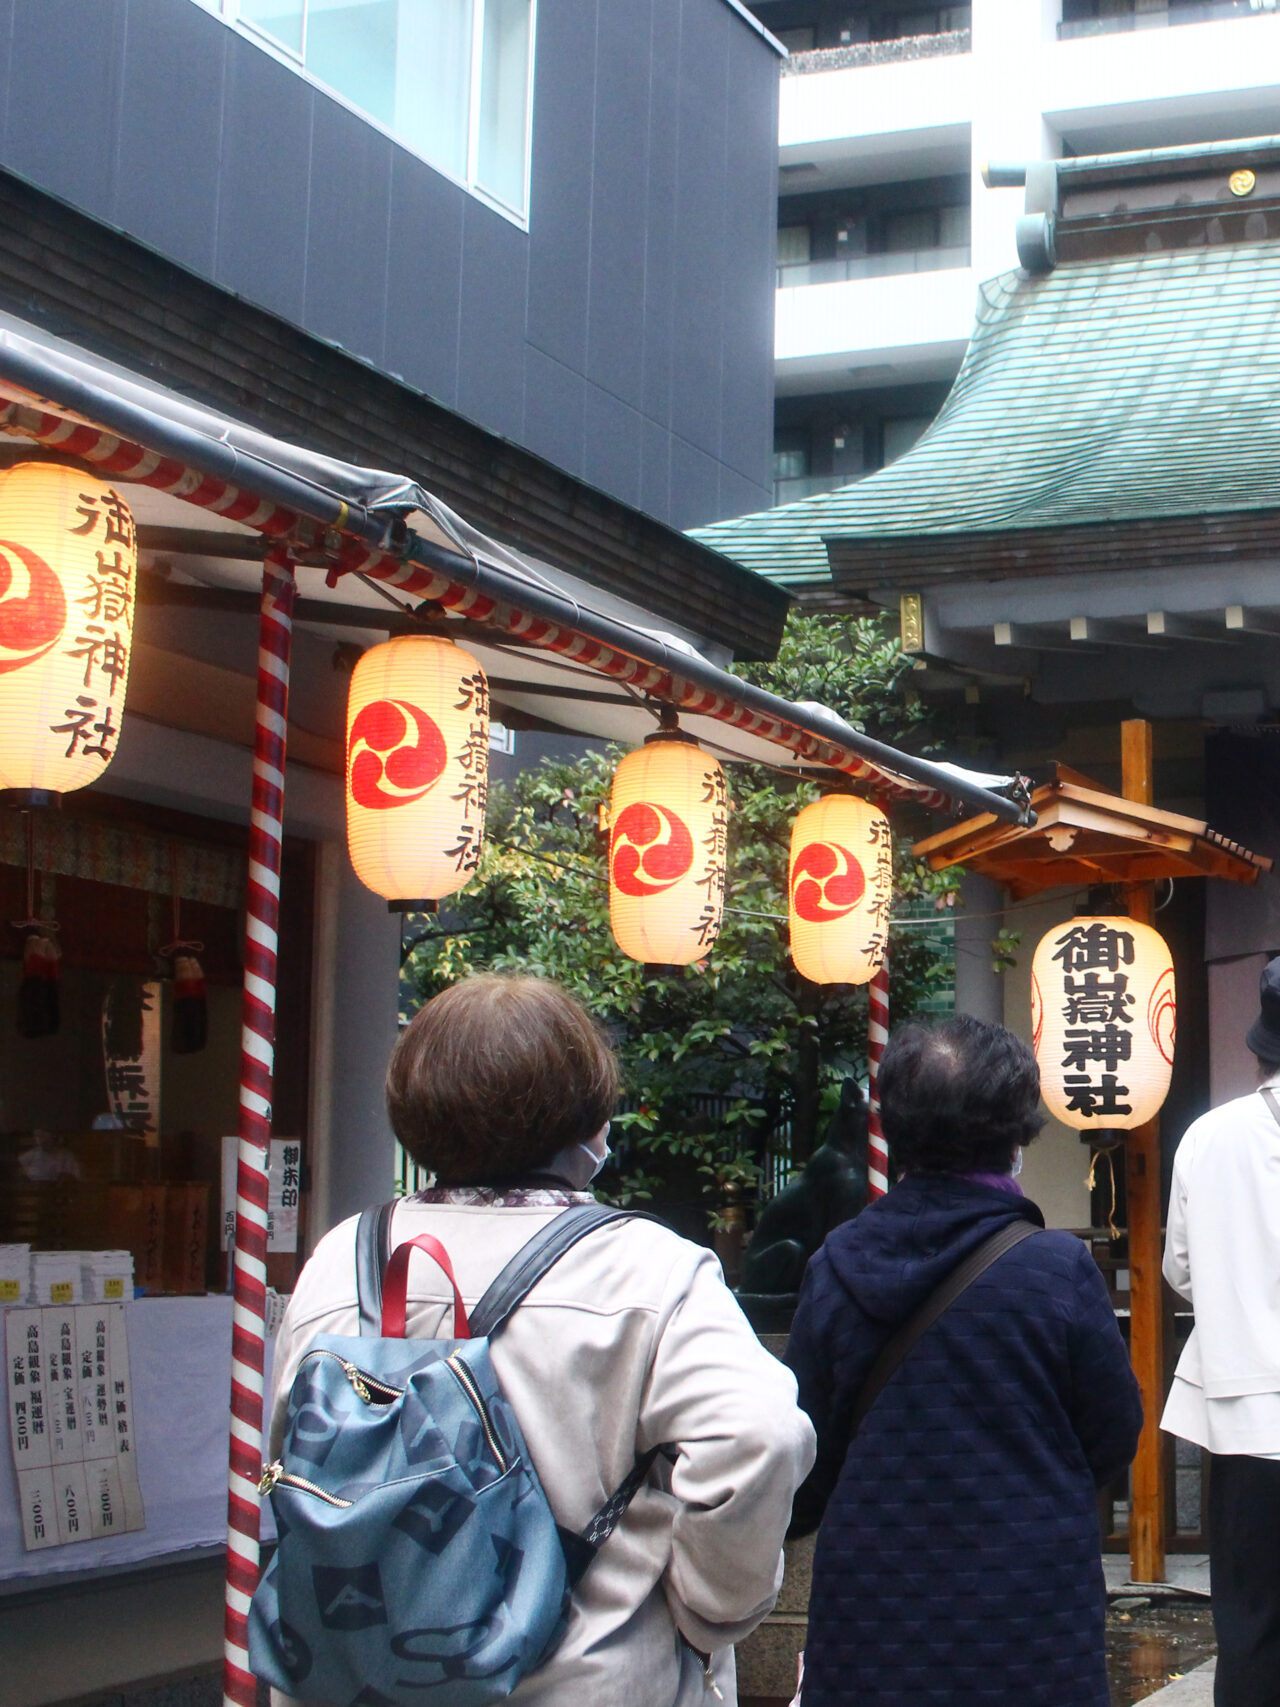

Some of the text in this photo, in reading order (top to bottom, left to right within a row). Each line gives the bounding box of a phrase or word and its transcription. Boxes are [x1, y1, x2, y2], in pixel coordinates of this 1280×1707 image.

[50, 488, 137, 761] 御嶽神社
[1051, 923, 1136, 1118] 御嶽神社
[281, 1146, 299, 1208] 御朱印
